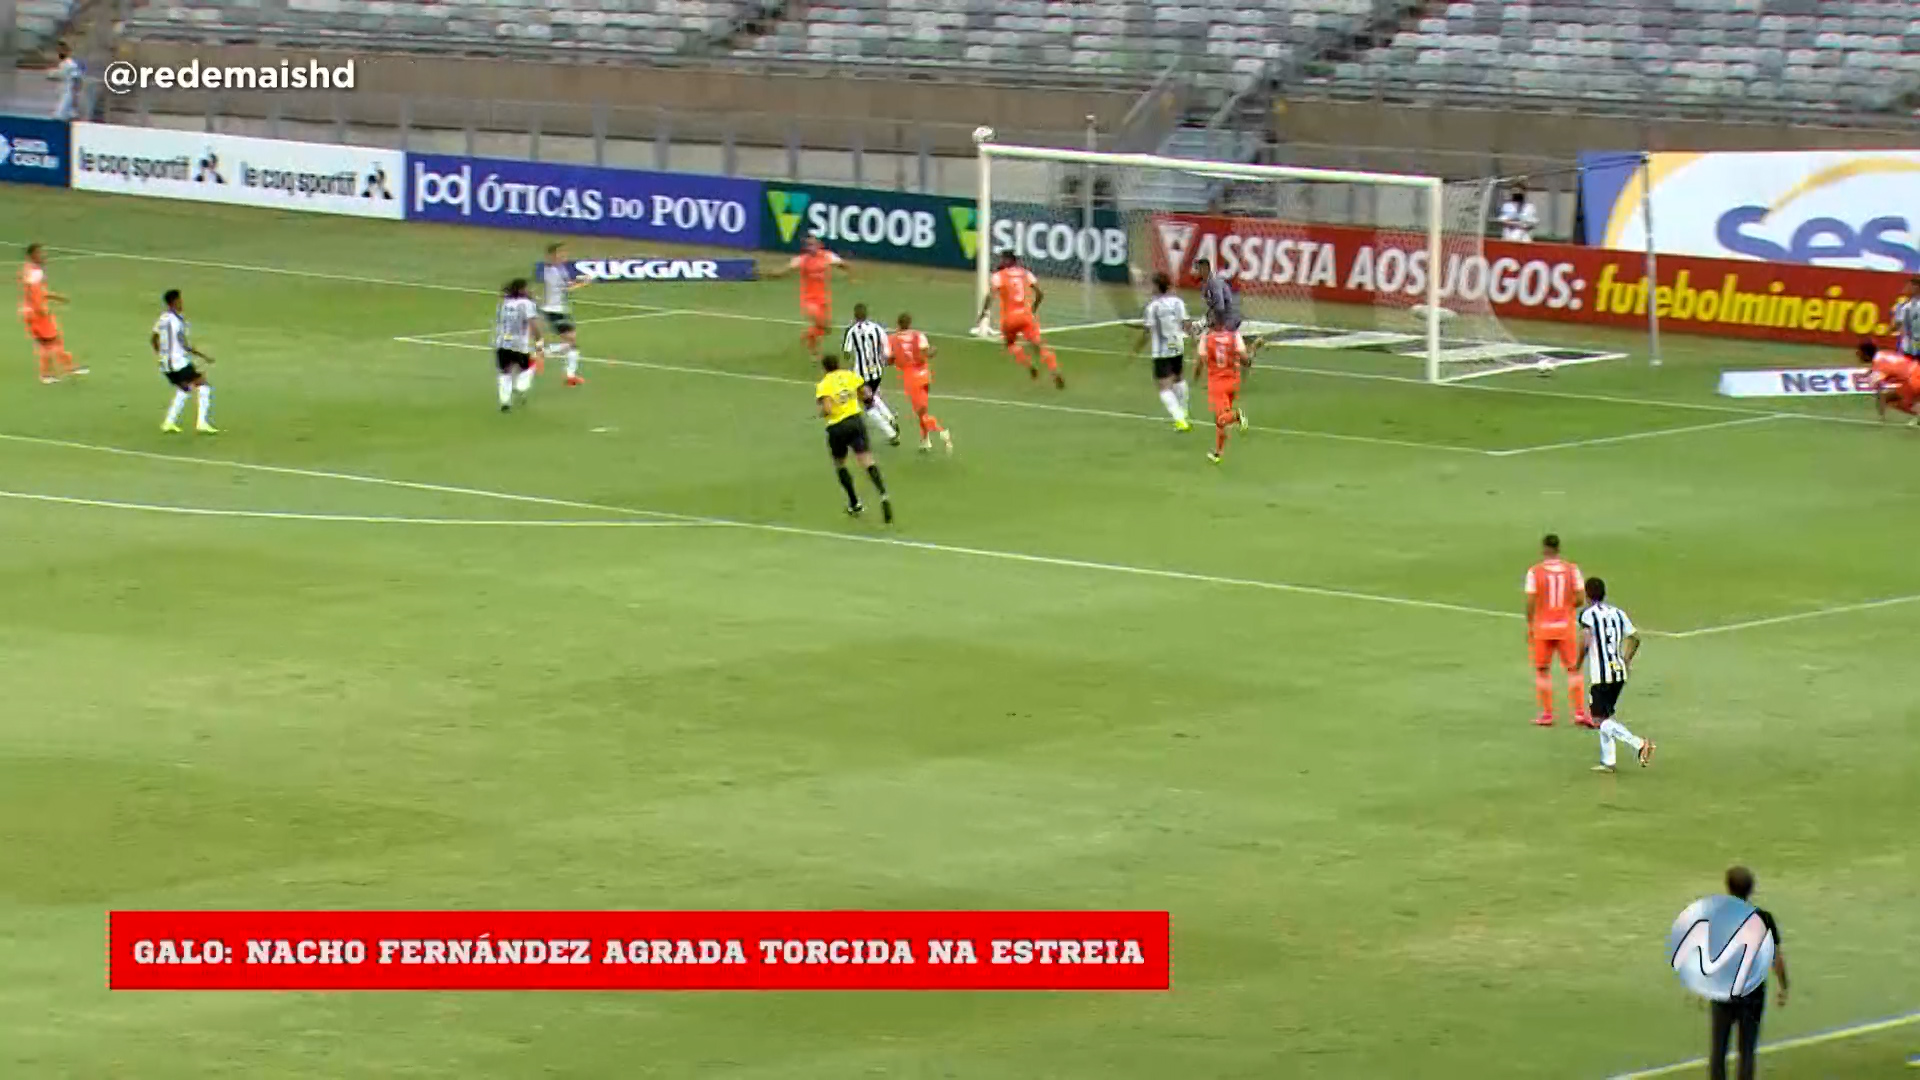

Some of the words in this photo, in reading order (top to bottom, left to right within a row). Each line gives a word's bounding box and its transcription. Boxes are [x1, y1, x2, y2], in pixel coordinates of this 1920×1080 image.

[97, 152, 130, 182] coq
[260, 167, 296, 197] coq
[477, 173, 603, 221] ÓTICAS
[609, 197, 644, 220] DO
[650, 194, 747, 234] POVO
[808, 202, 936, 248] SICOOB
[992, 217, 1128, 266] SICOOB
[575, 259, 720, 281] SUGGAR
[1192, 233, 1338, 288] ASSISTA
[1346, 245, 1430, 297] AOS
[1434, 250, 1586, 311] JOGOS:
[1595, 263, 1893, 337] futebolmineiro.
[1547, 573, 1567, 609] 11
